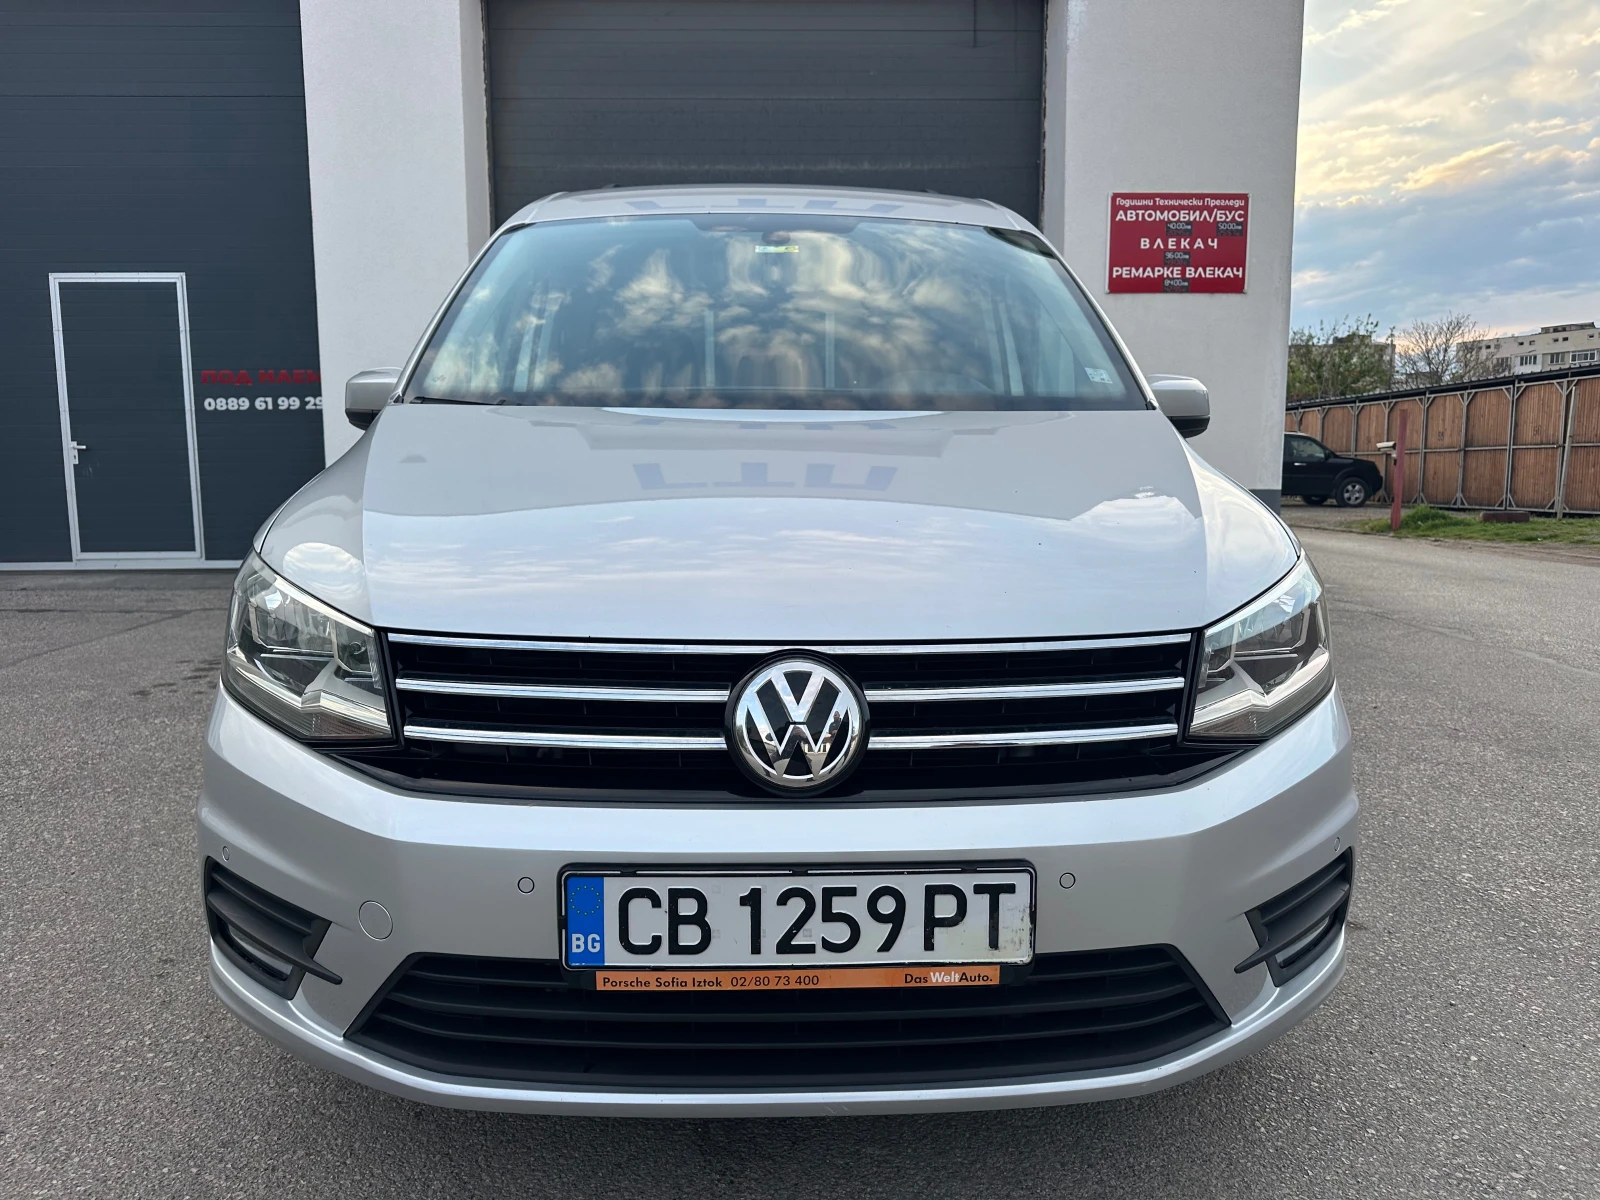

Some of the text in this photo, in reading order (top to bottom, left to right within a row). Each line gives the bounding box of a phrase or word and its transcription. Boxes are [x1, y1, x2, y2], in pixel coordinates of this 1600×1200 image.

[1116, 198, 1245, 207] Годишни Технически Прегледи
[1115, 209, 1245, 222] АВТОМОБИЛ/БУС
[1140, 238, 1218, 249] ВЛЕКАЧ
[1112, 267, 1243, 278] РЕМАРКЕ ВЛЕКАЧ
[201, 370, 253, 386] ПОД
[203, 397, 250, 411] 0889
[254, 397, 273, 410] 61
[277, 396, 301, 410] 99
[618, 882, 1017, 956] CB 1259 PT
[571, 933, 601, 953] BG
[603, 975, 819, 988] Porsche Sofia Iztok 02/80 73 400
[904, 971, 993, 984] Das WeltAuto.
